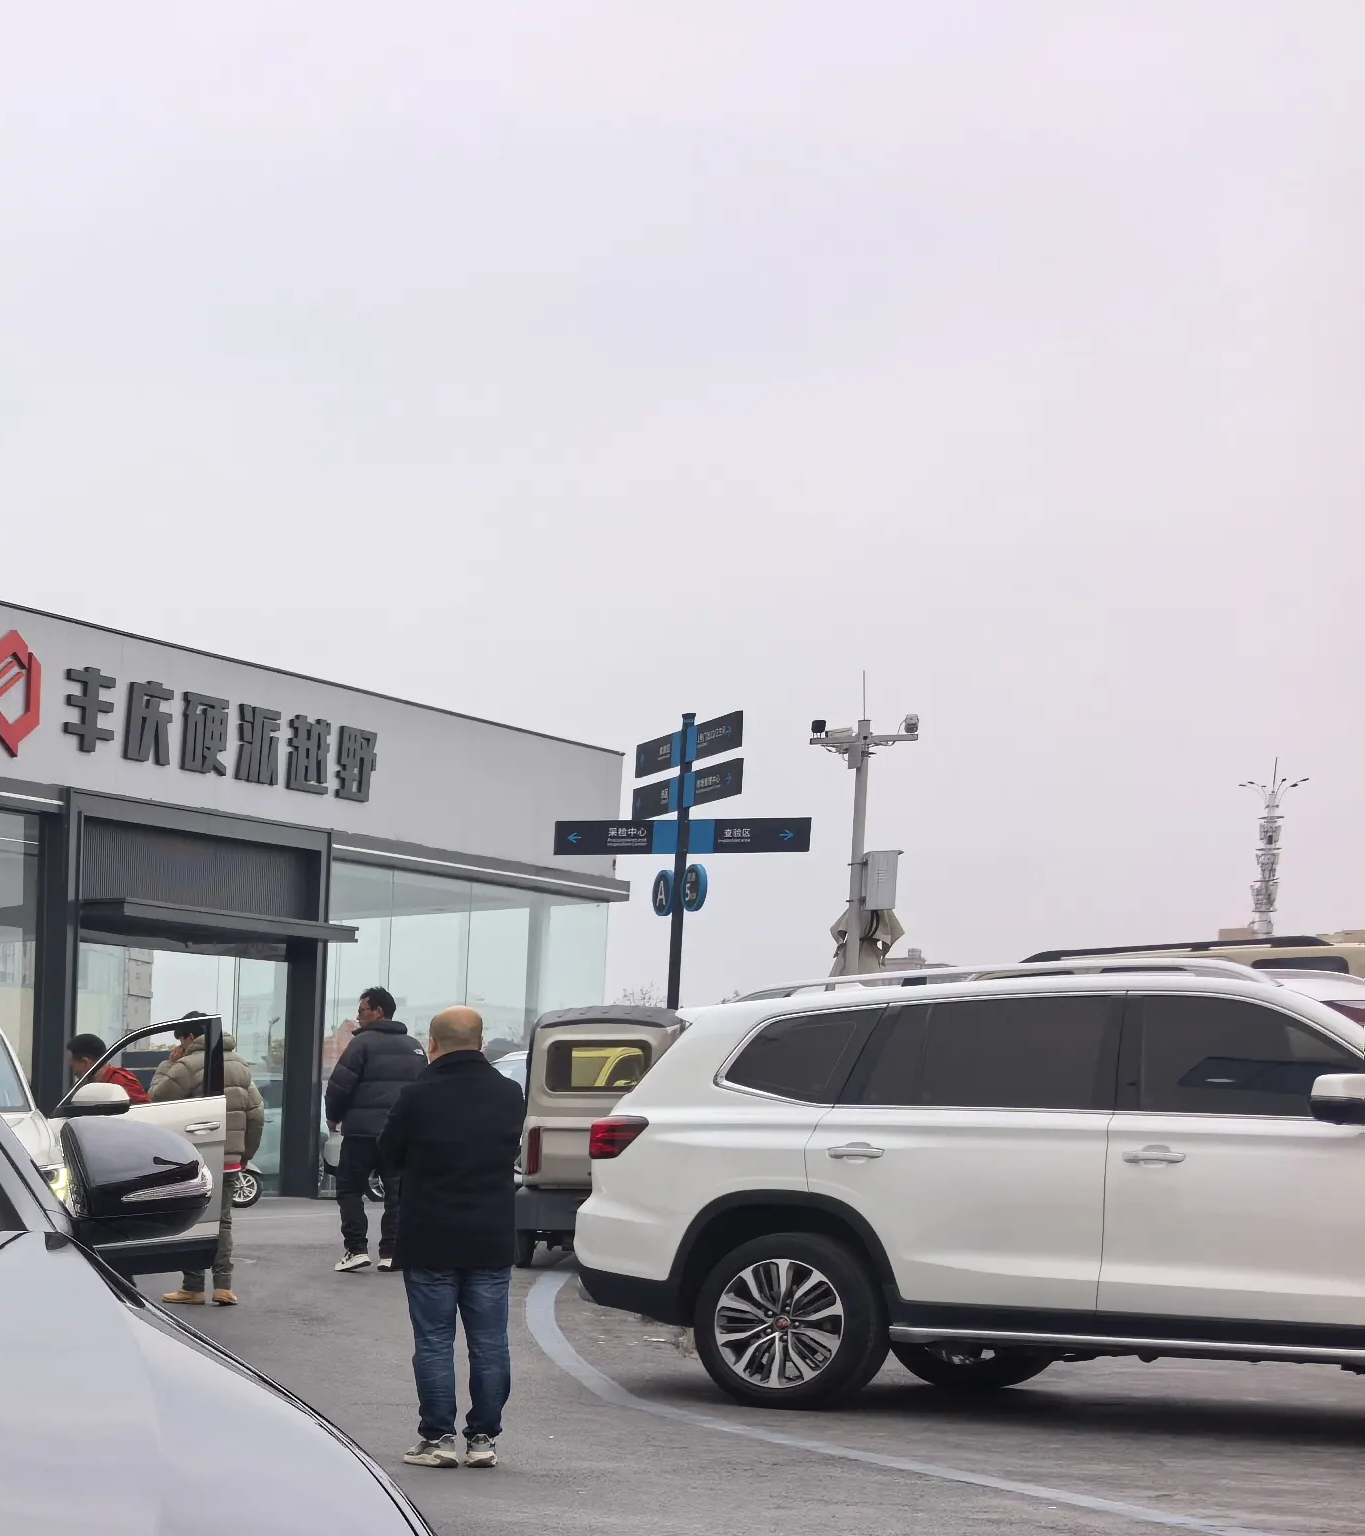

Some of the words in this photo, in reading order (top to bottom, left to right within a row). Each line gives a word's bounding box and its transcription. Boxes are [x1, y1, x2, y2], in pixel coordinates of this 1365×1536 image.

[63, 666, 377, 803] 丰庆硬派越野
[723, 827, 751, 838] 查验区
[656, 880, 666, 907] A
